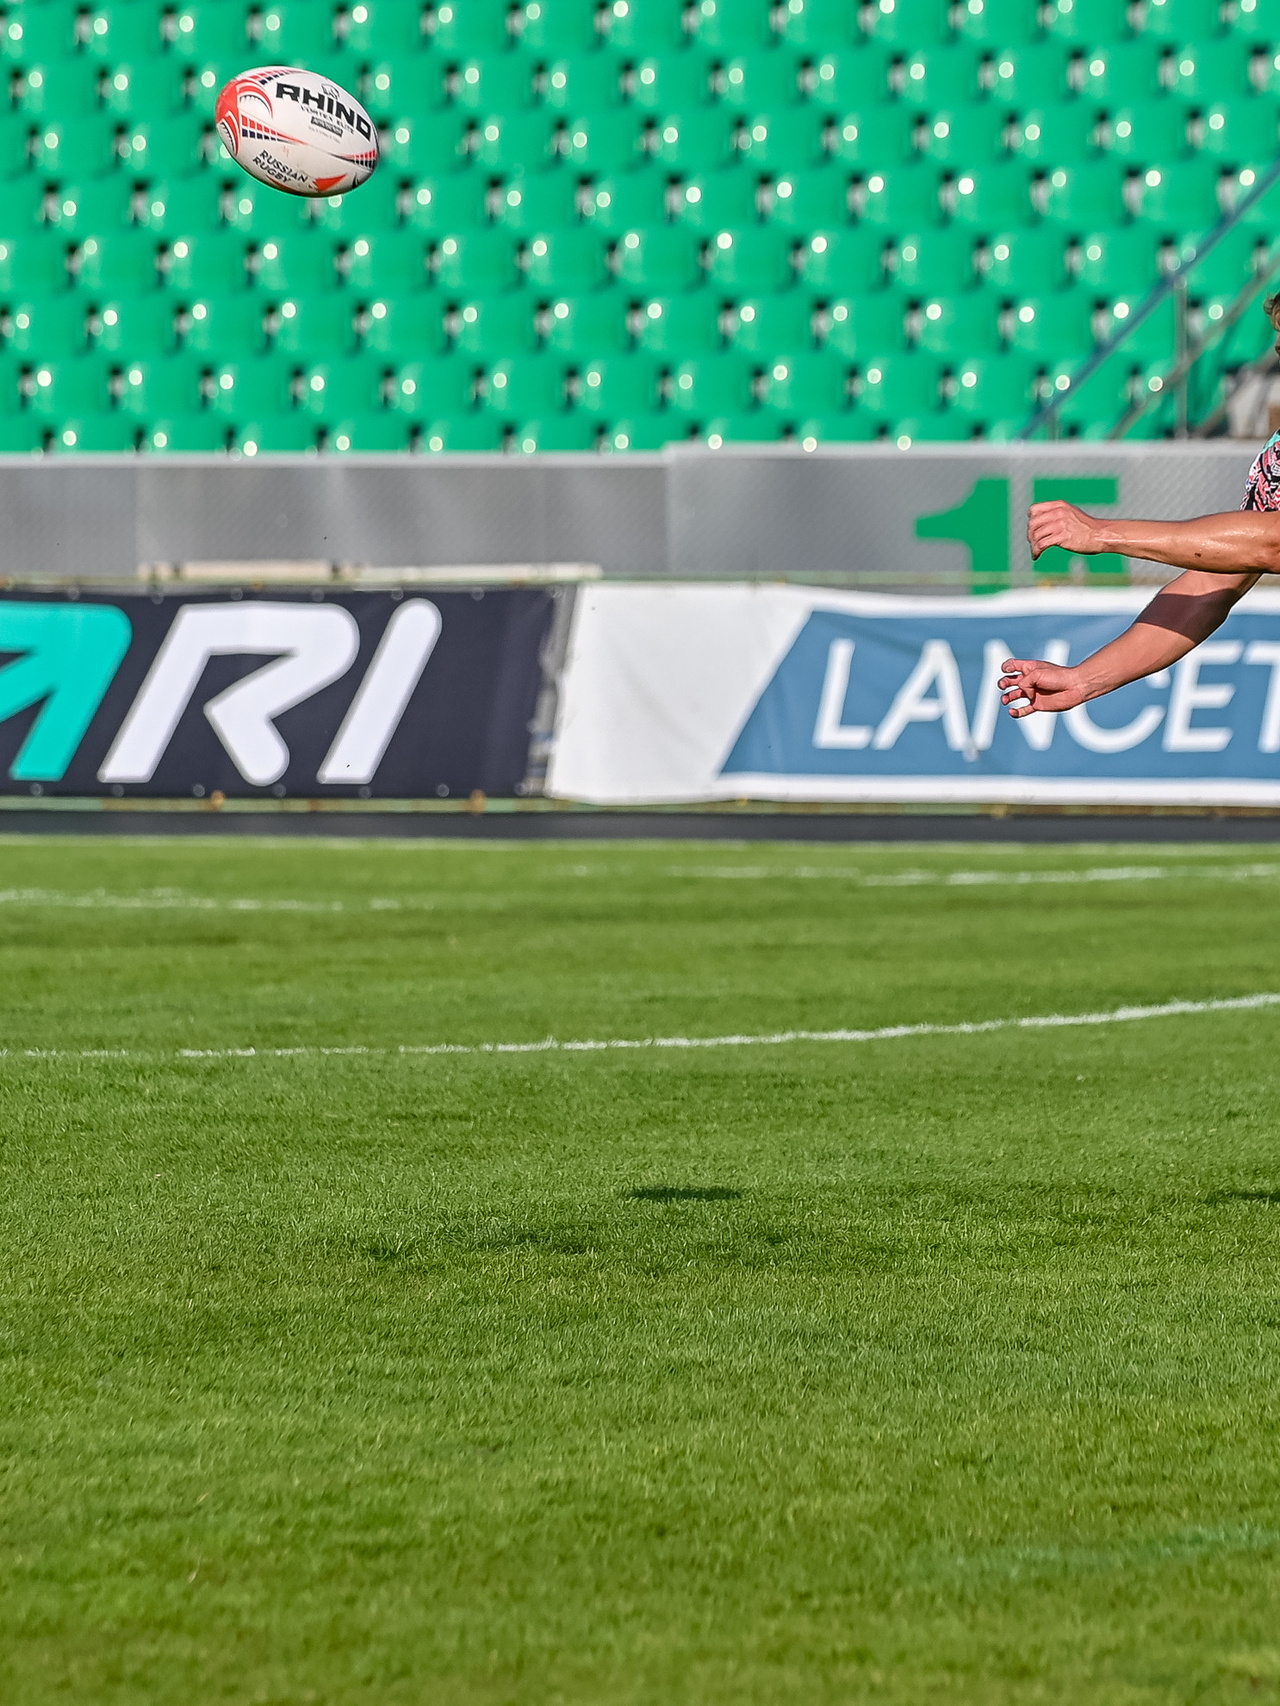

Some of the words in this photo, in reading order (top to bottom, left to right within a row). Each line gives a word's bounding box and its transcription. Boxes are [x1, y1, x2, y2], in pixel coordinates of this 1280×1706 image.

[275, 82, 371, 142] RHINO
[252, 156, 291, 183] RUGBY
[259, 149, 309, 183] RUSSIAN
